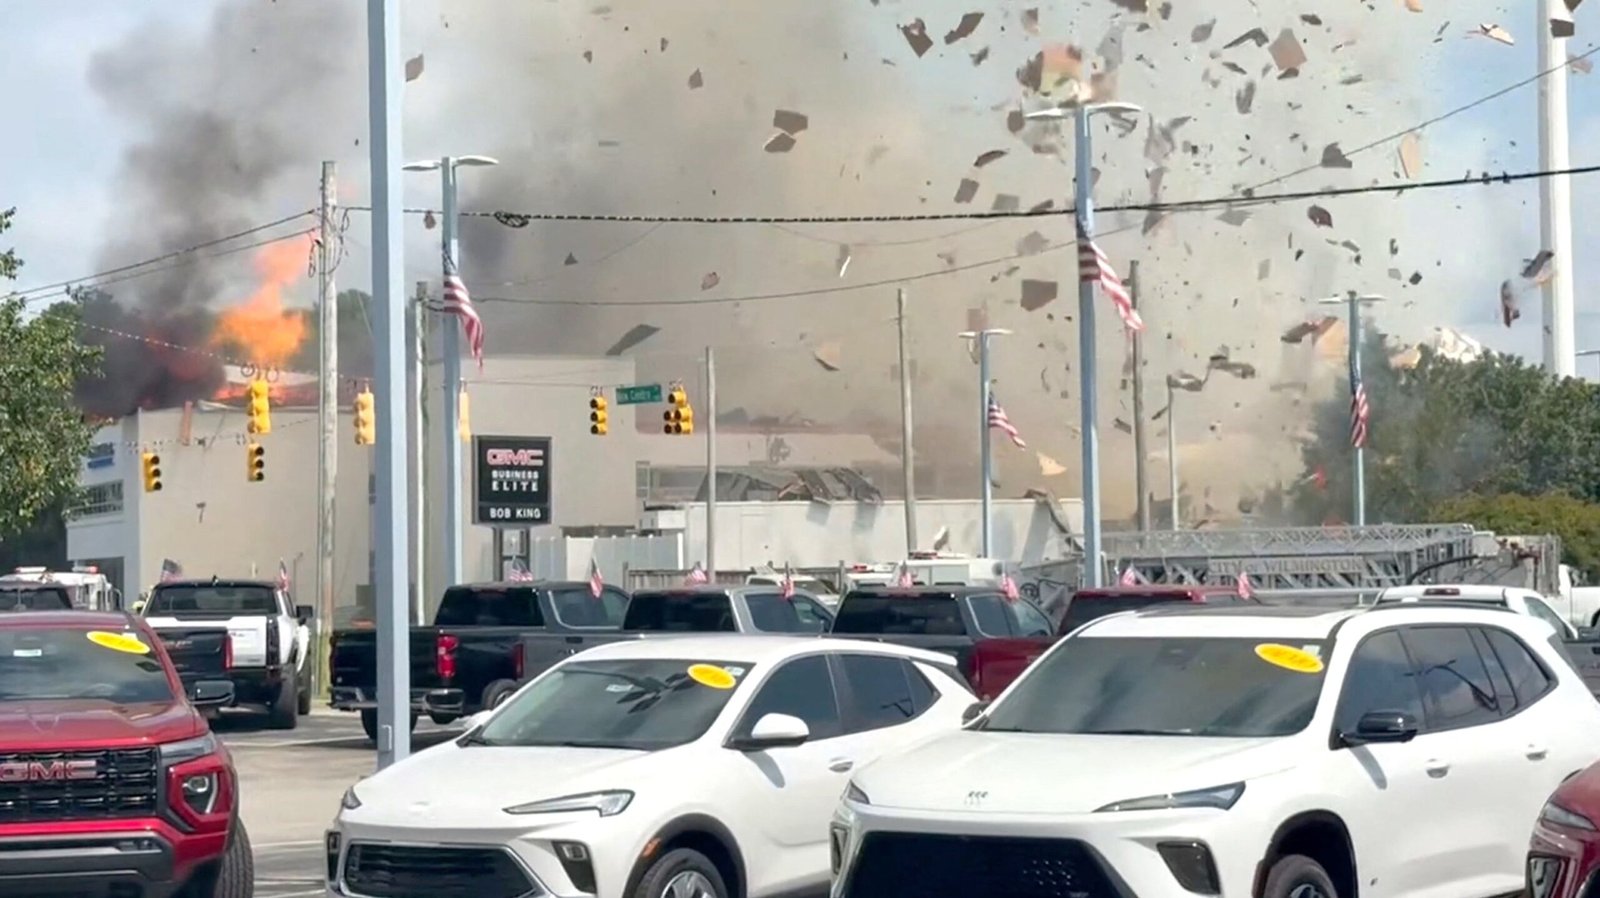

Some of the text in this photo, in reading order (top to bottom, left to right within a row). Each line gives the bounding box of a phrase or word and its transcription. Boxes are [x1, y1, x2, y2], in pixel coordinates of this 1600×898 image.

[486, 448, 544, 466] GMC
[491, 469, 539, 479] BUSINESS
[491, 480, 539, 492] ELITE
[489, 507, 541, 519] BOB KING
[1208, 561, 1242, 574] CITY
[1264, 558, 1362, 573] WILMINGTON
[0, 760, 97, 781] GMC
